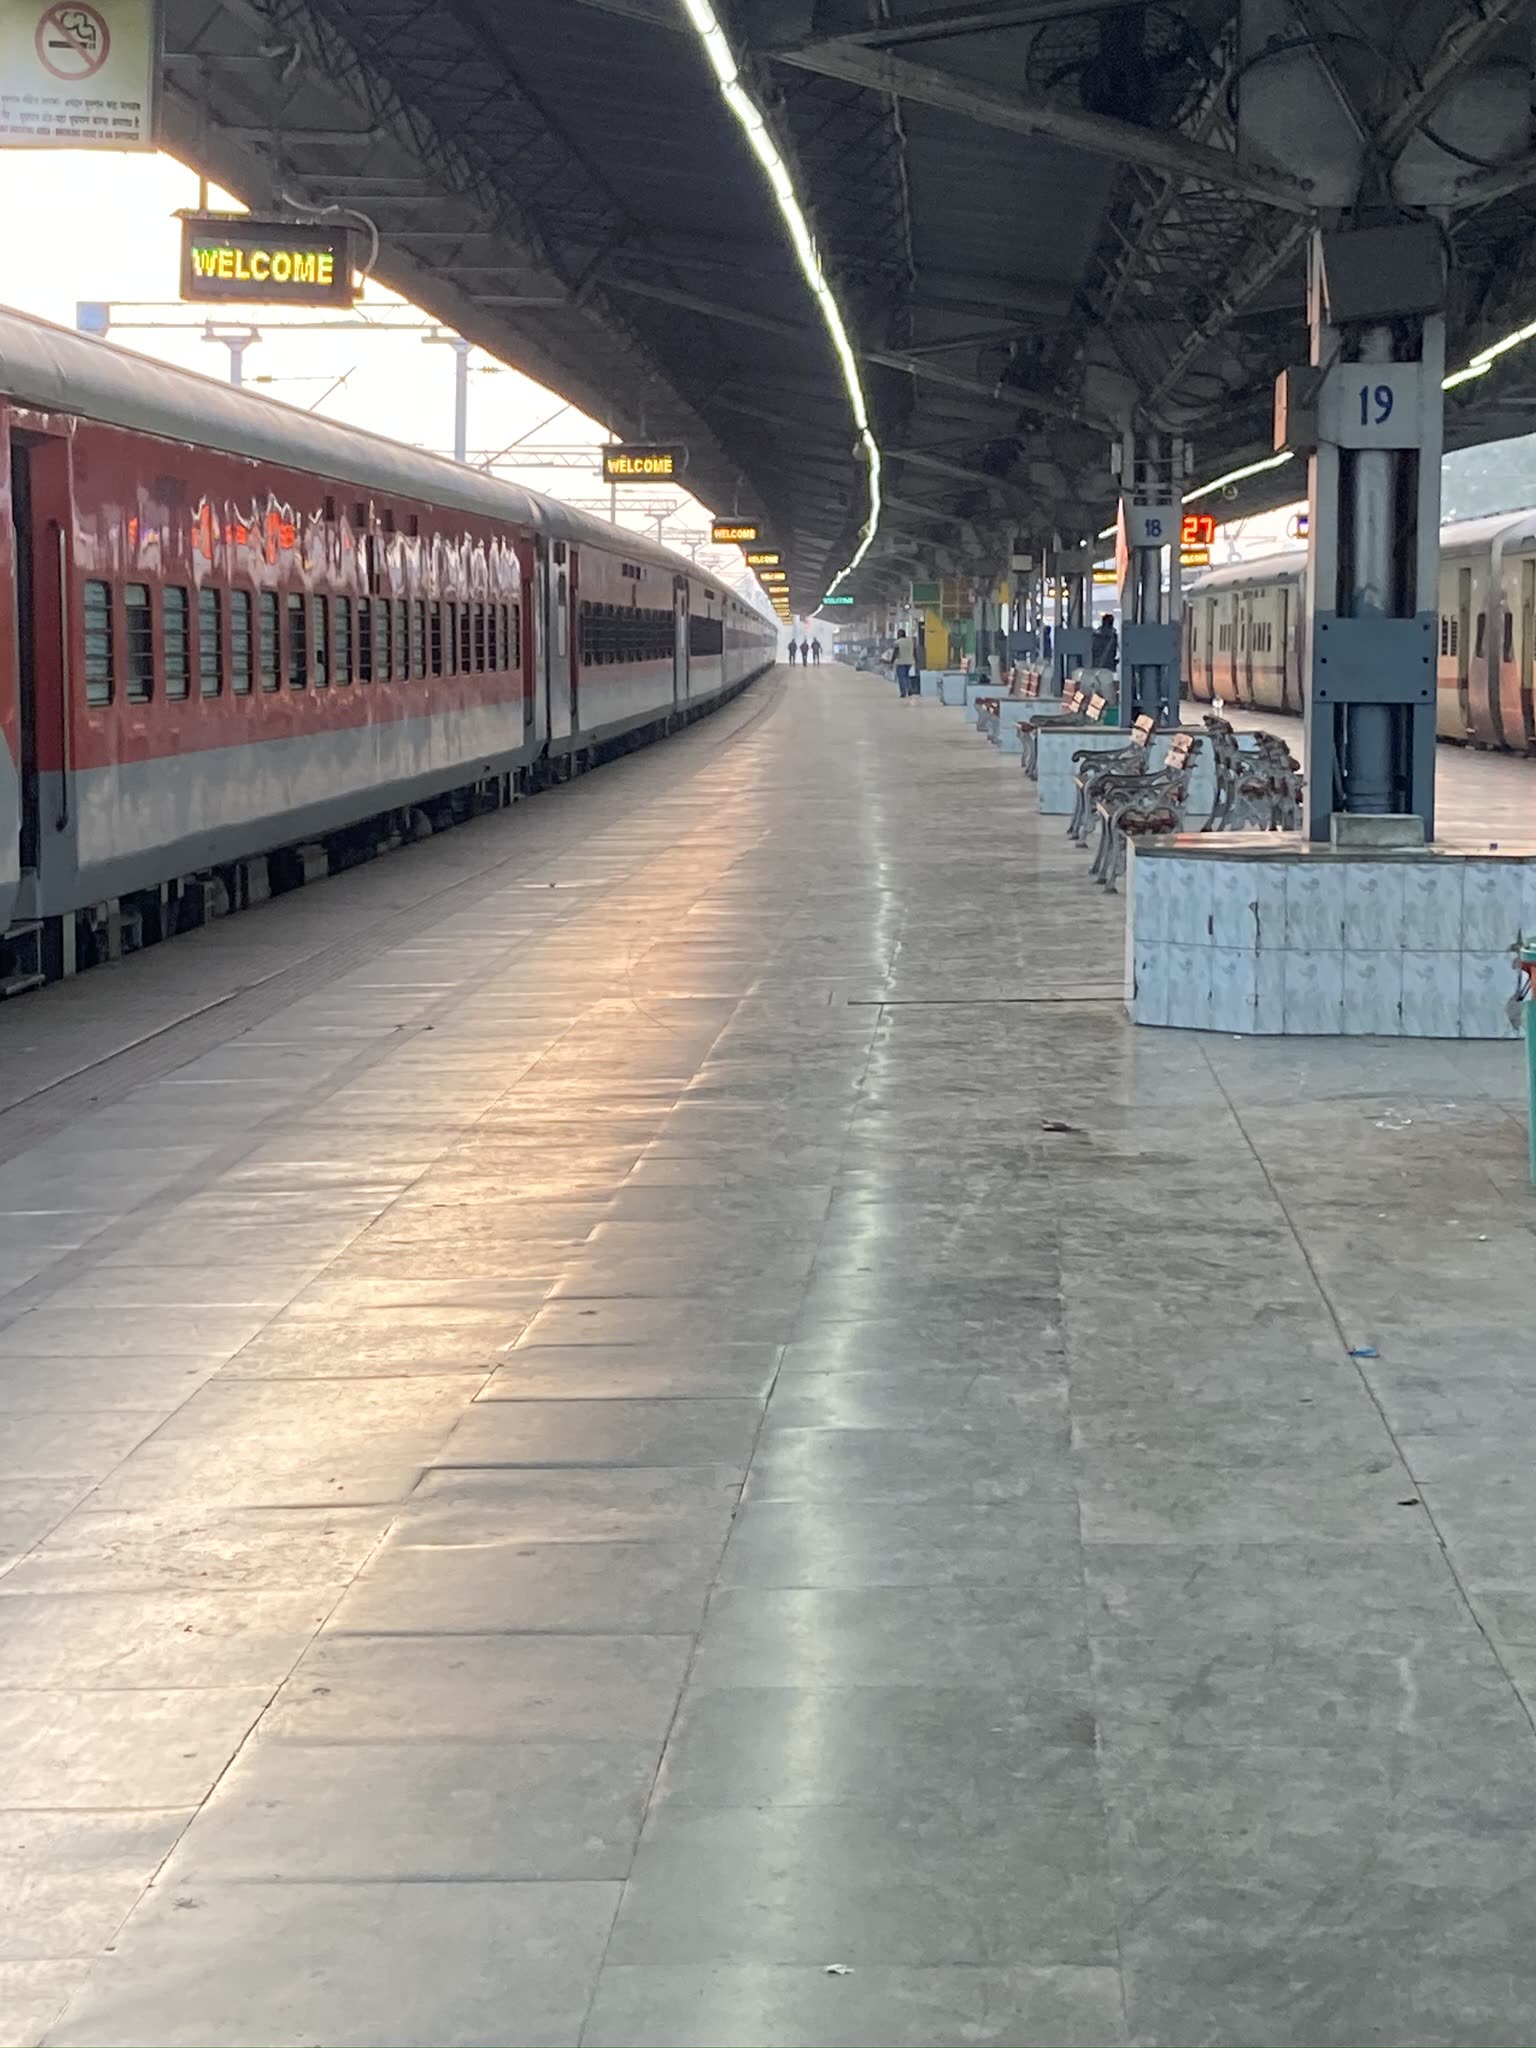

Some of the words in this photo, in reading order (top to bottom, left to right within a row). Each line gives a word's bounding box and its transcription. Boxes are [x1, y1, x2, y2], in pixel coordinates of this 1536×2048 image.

[192, 246, 334, 285] WELCOME
[1360, 385, 1394, 427] 19
[607, 455, 673, 474] WELCOME
[713, 527, 756, 540] WELCOME
[1145, 519, 1162, 537] 18
[1183, 516, 1212, 543] 27
